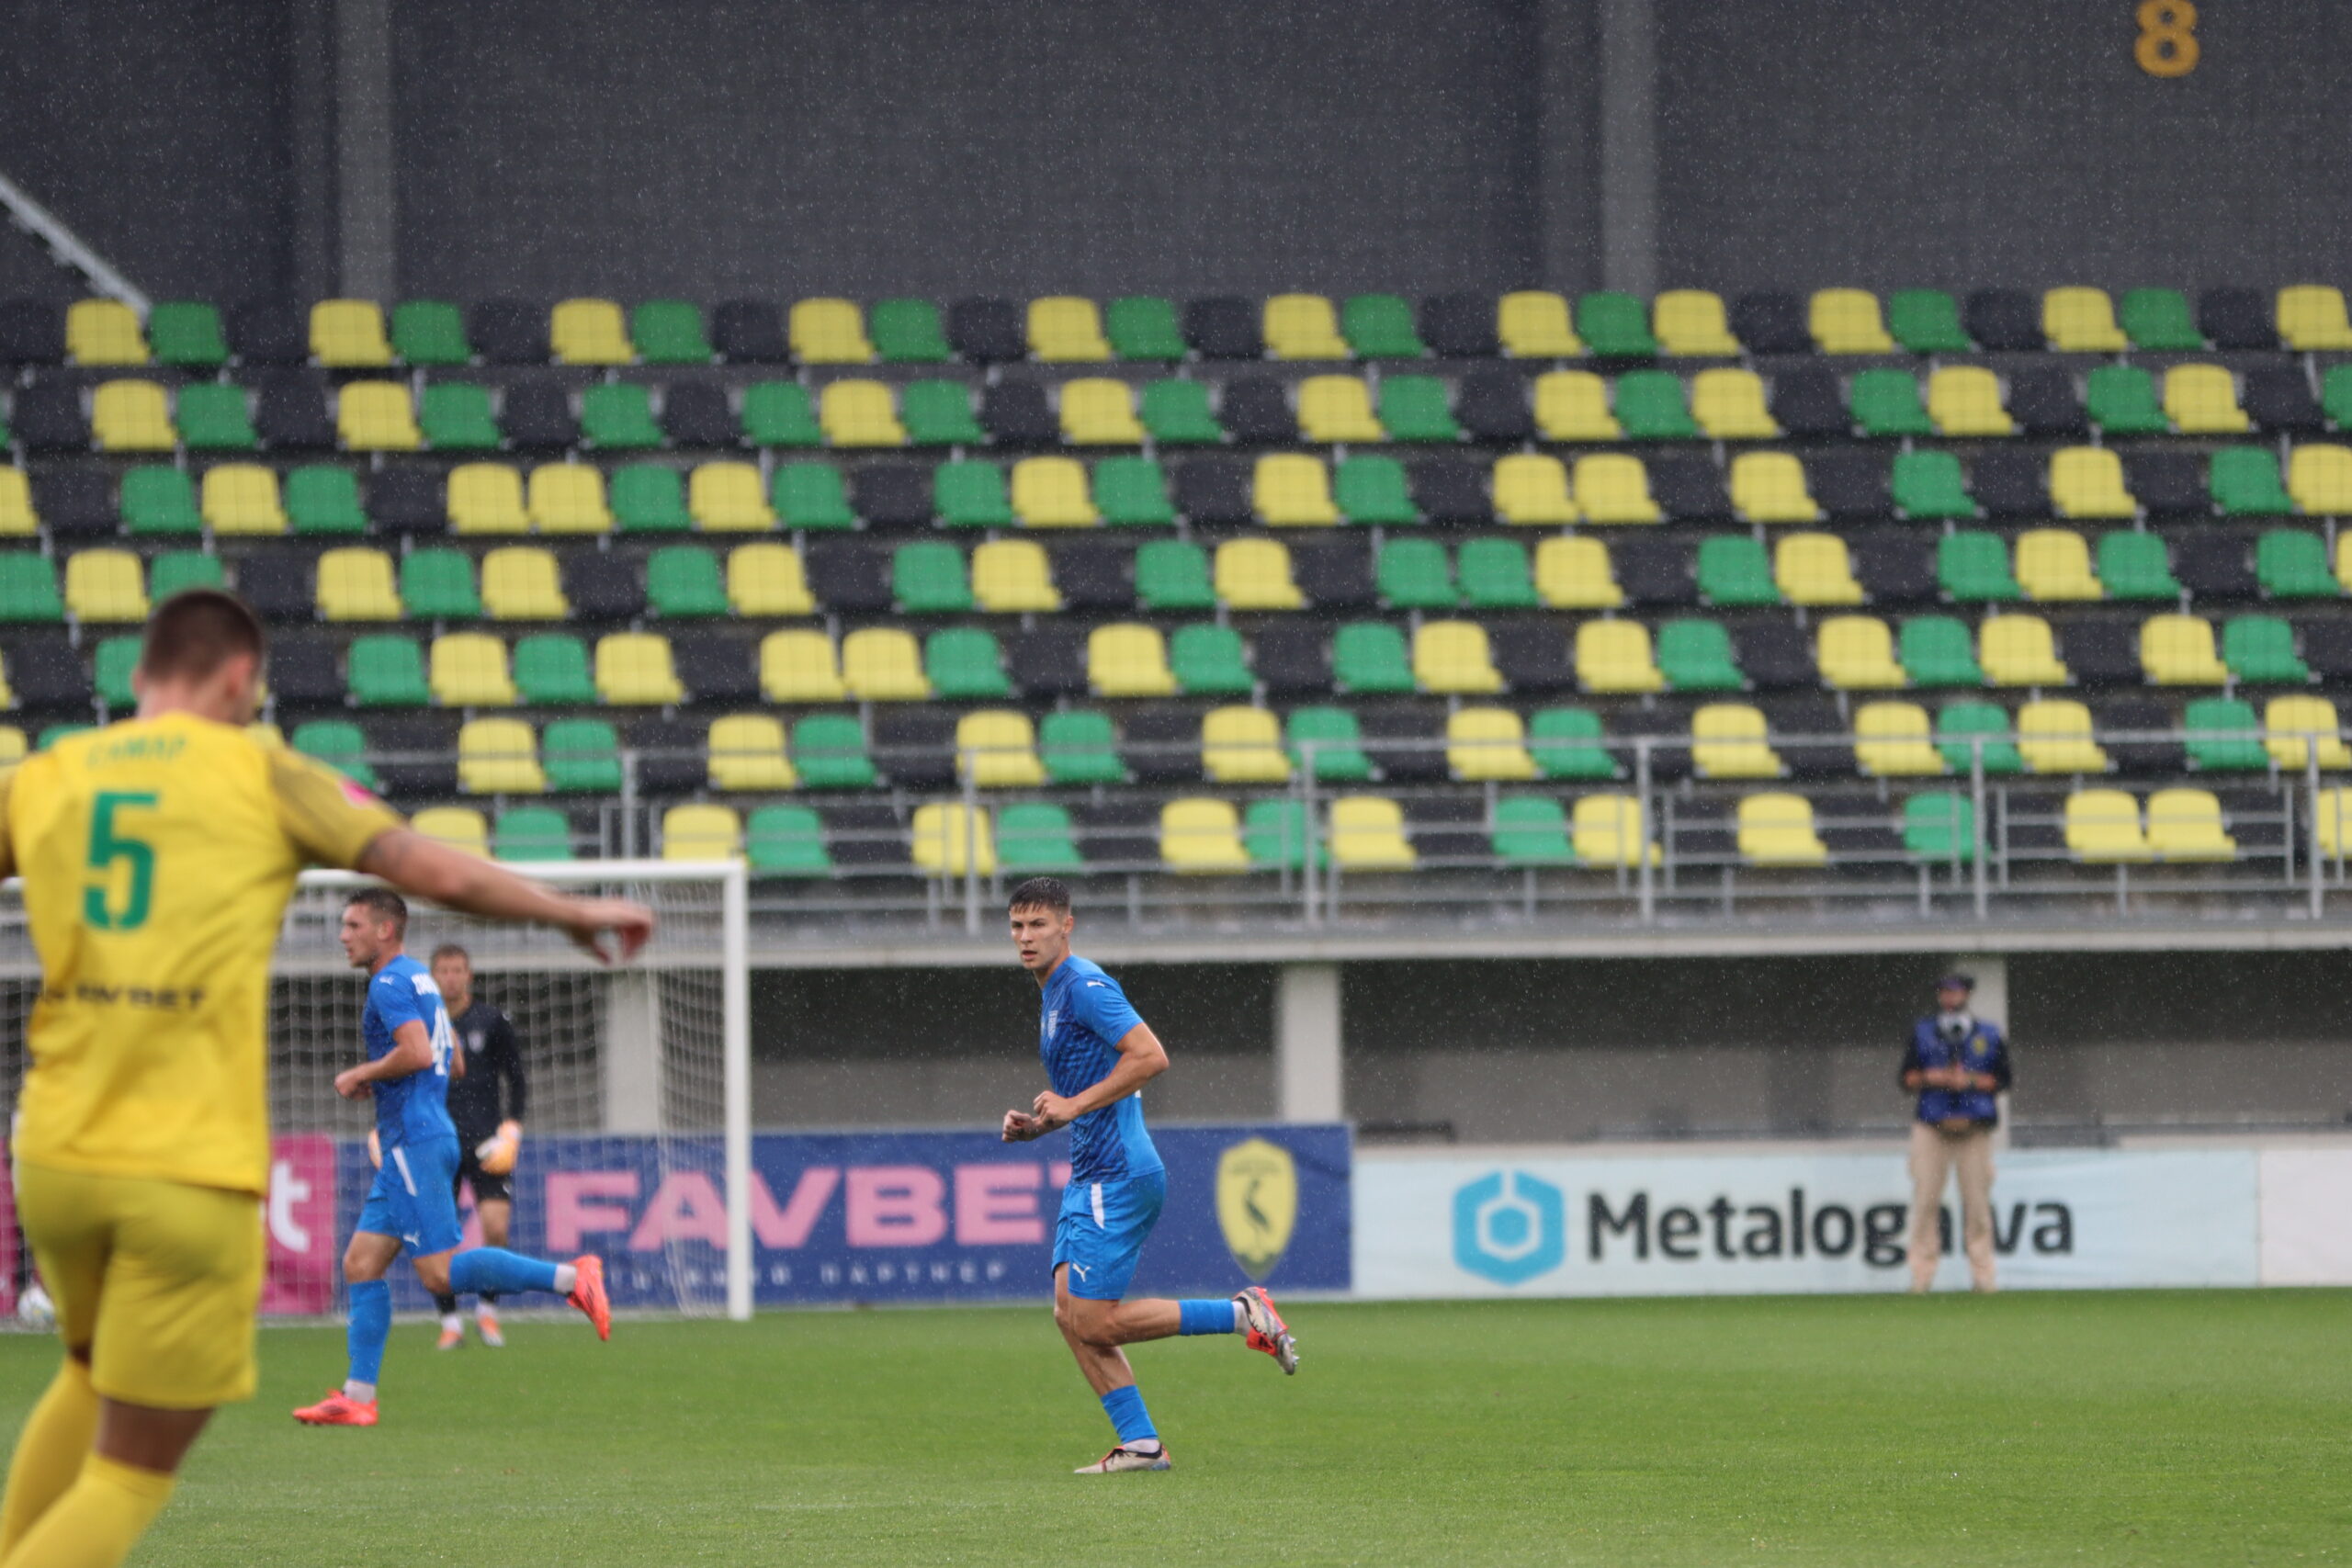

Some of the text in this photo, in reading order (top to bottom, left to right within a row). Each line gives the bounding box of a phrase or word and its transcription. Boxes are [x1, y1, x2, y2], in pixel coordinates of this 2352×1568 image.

[2133, 0, 2200, 78] 8
[83, 791, 159, 931] 5
[1589, 1183, 2073, 1268] Metalogva
